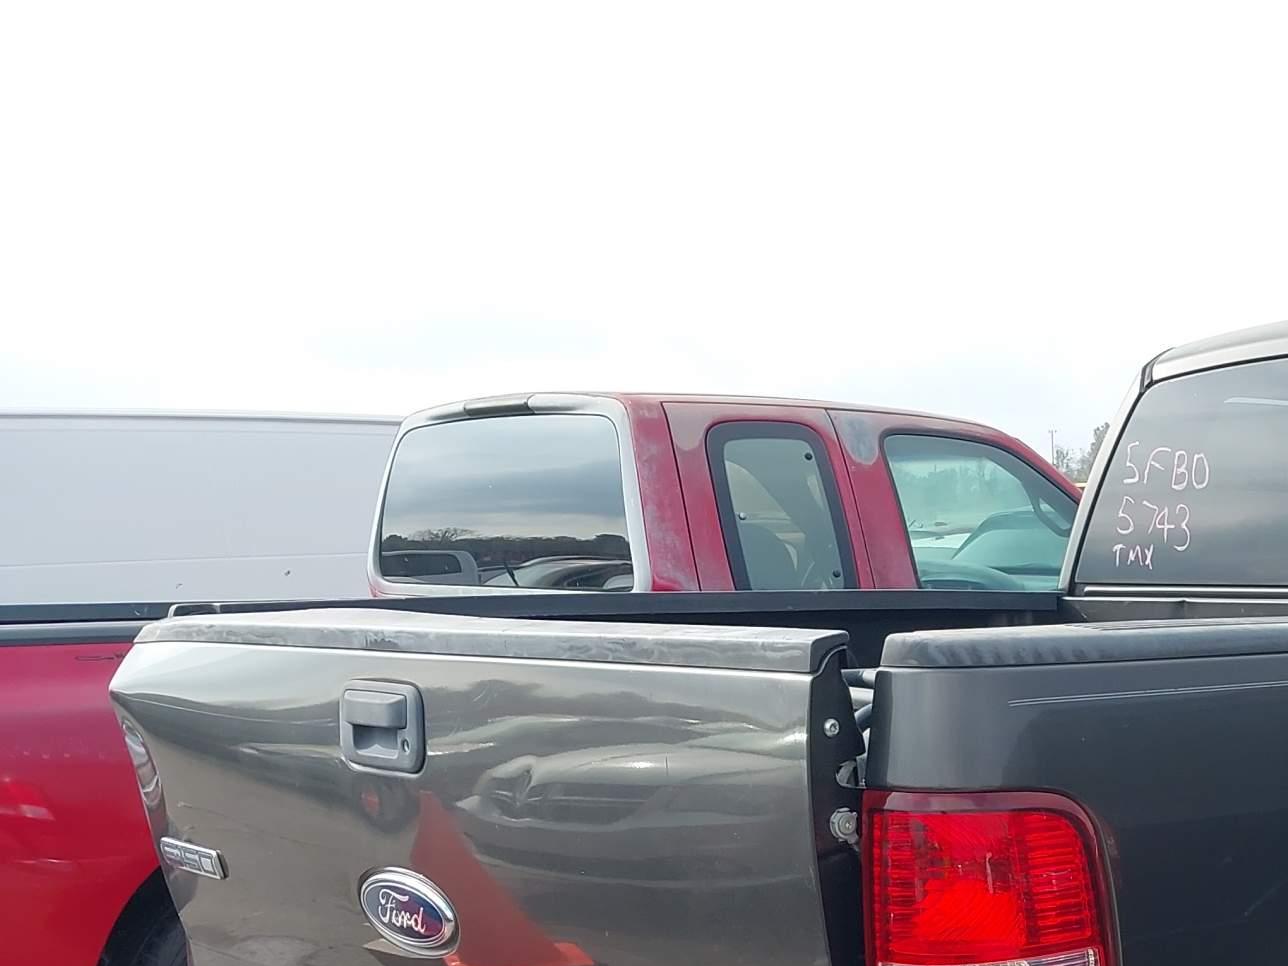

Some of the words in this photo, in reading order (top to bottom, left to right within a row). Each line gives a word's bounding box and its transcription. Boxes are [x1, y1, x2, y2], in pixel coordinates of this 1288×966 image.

[1116, 495, 1191, 552] 5743
[1112, 543, 1154, 570] TMX
[378, 888, 426, 934] Ford
